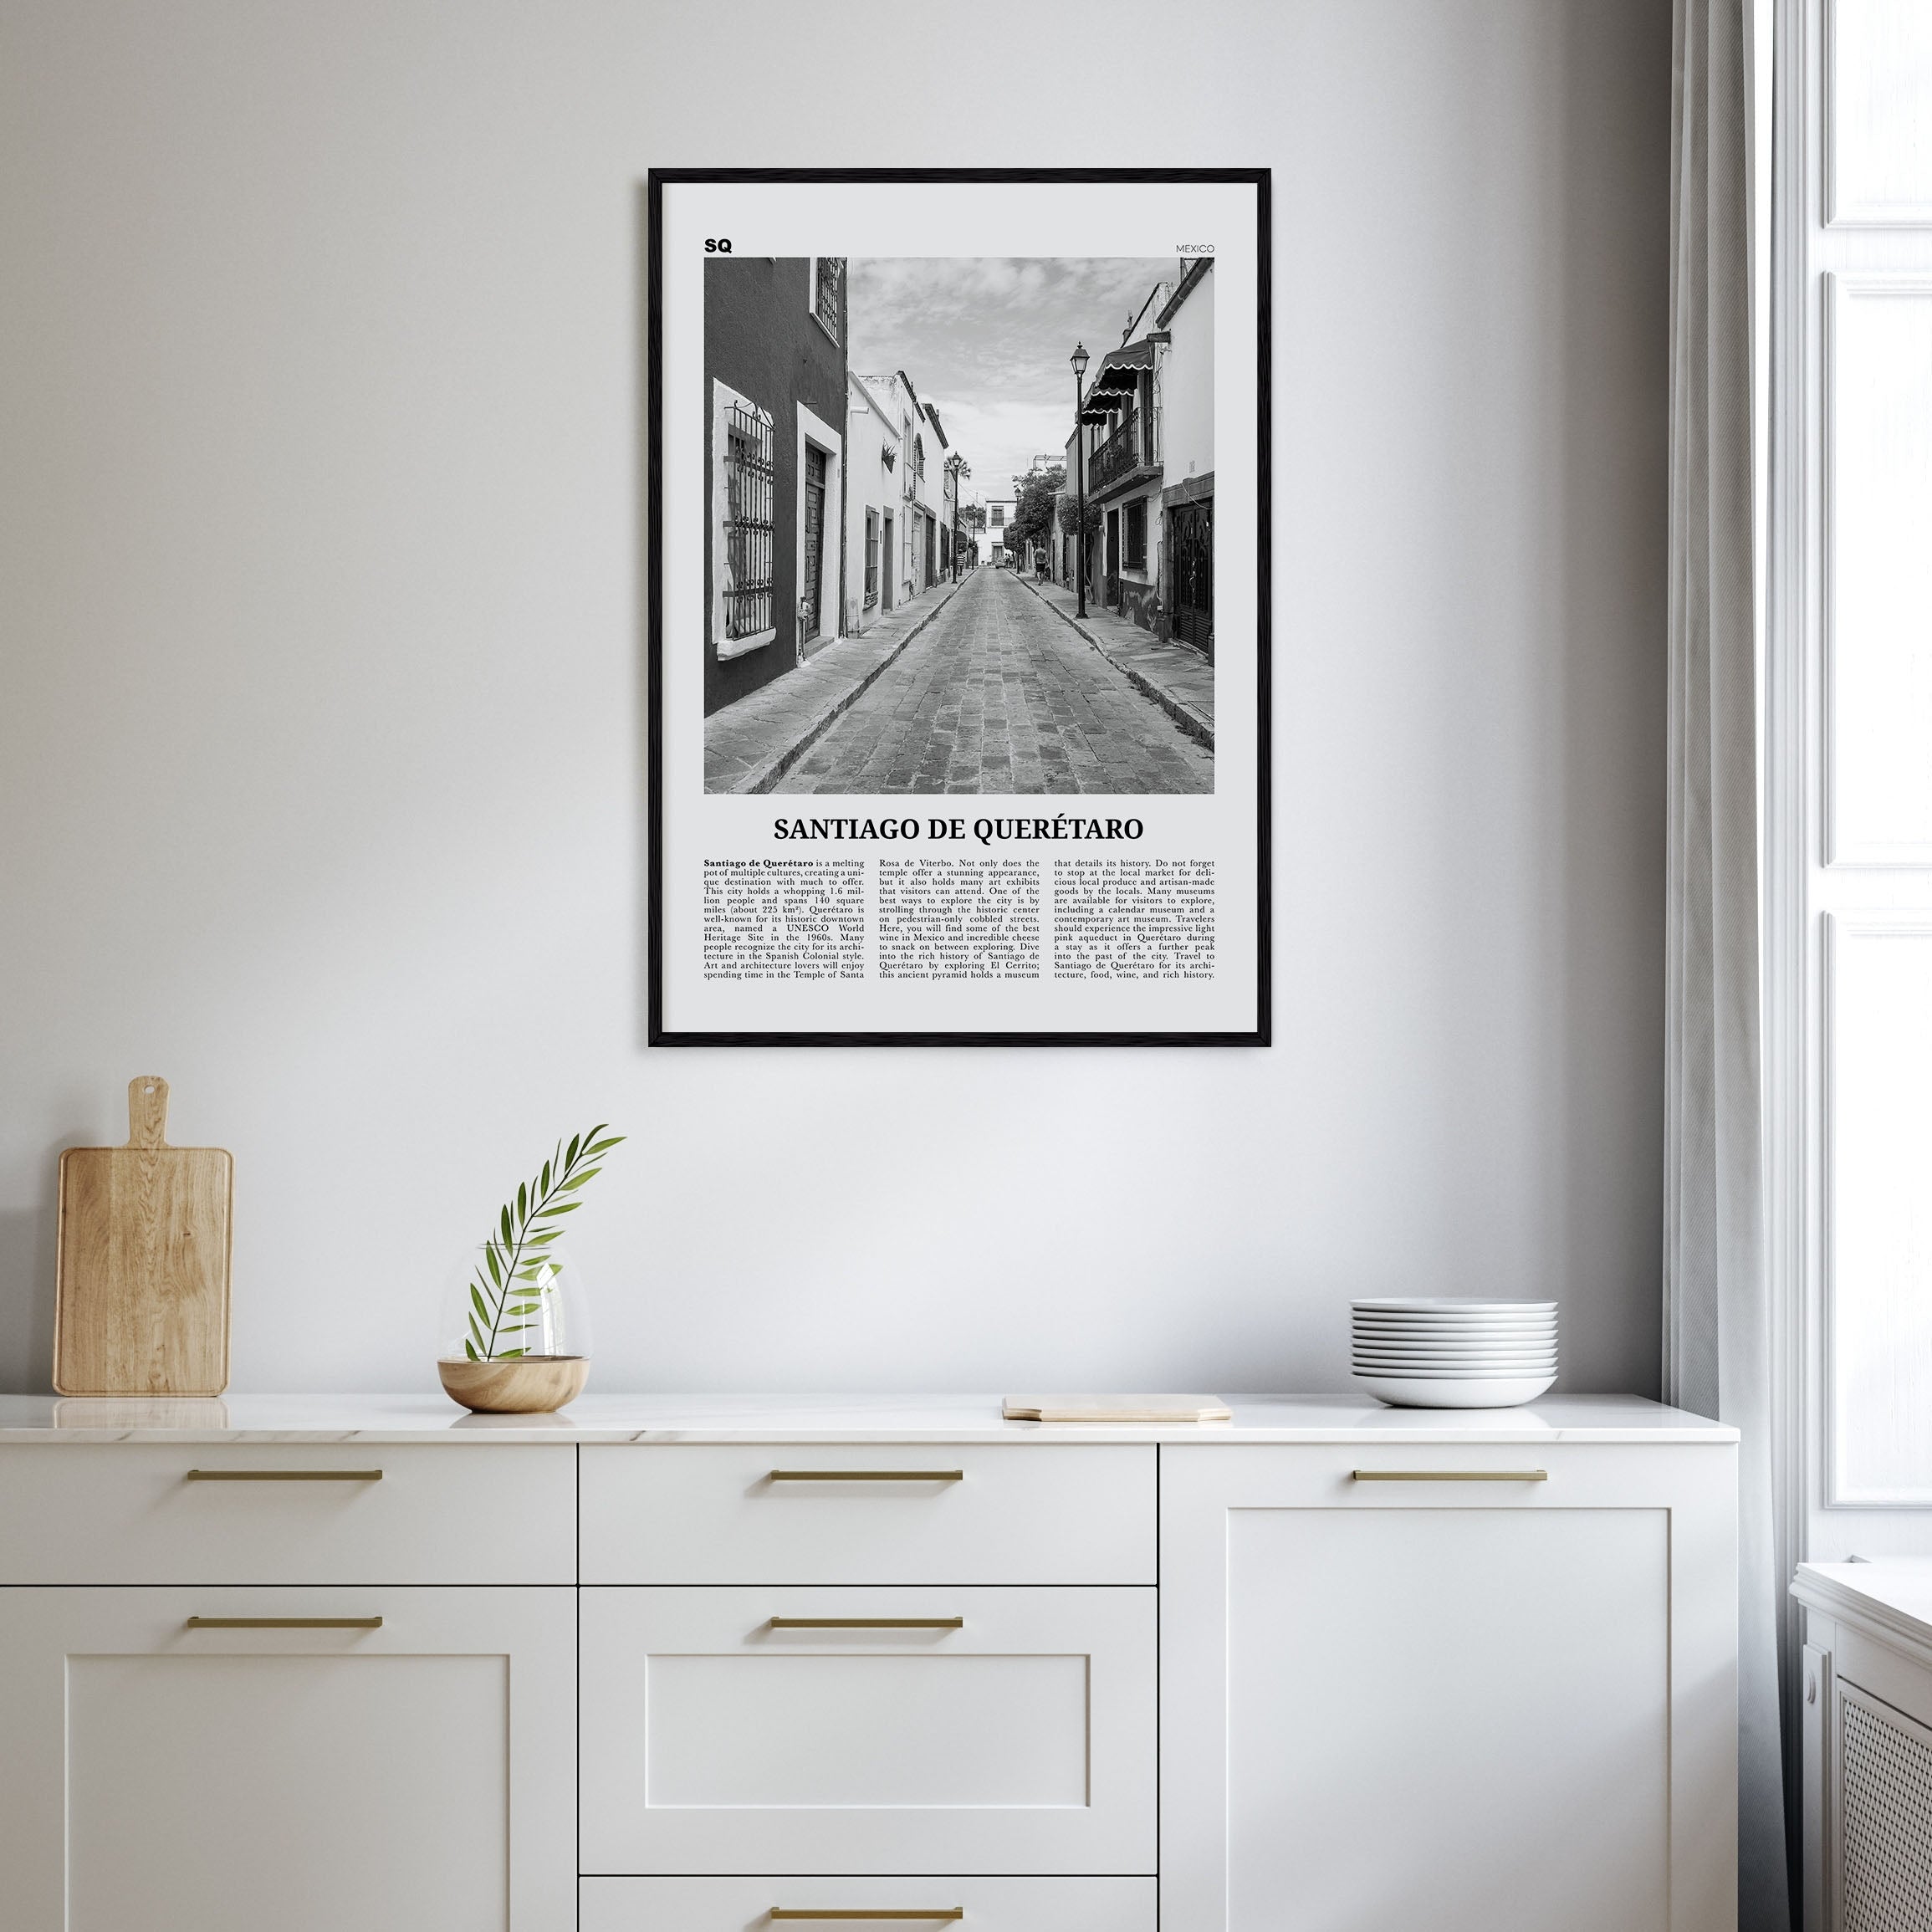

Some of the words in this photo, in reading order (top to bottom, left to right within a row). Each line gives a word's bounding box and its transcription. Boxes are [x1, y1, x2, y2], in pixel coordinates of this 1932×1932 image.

[704, 238, 732, 253] SQ
[774, 819, 919, 839] SANTIAGO
[928, 819, 965, 839] DE
[974, 814, 1143, 845] QUERÉTARO
[703, 859, 747, 869] Santiago
[749, 859, 761, 867] de
[763, 859, 814, 869] Querétaro
[815, 859, 823, 867] is
[832, 859, 865, 869] melting
[879, 859, 900, 867] Rosa
[904, 859, 915, 867] de
[919, 859, 954, 867] Viterbo.
[958, 859, 975, 867] Not
[979, 859, 999, 869] only
[1002, 859, 1022, 867] does
[1025, 859, 1040, 867] the
[1054, 859, 1071, 867] that
[1075, 859, 1103, 867] details
[1106, 859, 1117, 867] its
[1120, 859, 1152, 869] history.
[1155, 859, 1168, 867] Do
[1189, 859, 1215, 869] forget
[703, 870, 718, 878] pot
[718, 868, 730, 877] of
[730, 868, 766, 878] multiple
[766, 868, 804, 877] cultures,
[804, 868, 840, 878] creating
[846, 868, 865, 877] uni-
[879, 868, 908, 878] temple
[912, 868, 933, 877] offer
[946, 868, 984, 878] stunning
[723, 877, 772, 886] destination
[776, 877, 795, 886] with
[800, 877, 824, 886] much
[841, 877, 864, 886] offer.
[1054, 877, 1076, 886] cious
[1079, 877, 1100, 886] local
[1102, 877, 1137, 887] produce
[1140, 877, 1157, 886] and
[1158, 877, 1215, 886] artisan-made
[1054, 887, 1079, 897] goods
[1083, 887, 1094, 897] by
[1147, 887, 1173, 897] Many
[1180, 897, 1215, 907] explore,
[730, 906, 758, 916] (about
[809, 906, 854, 916] Querétaro
[878, 906, 915, 916] strolling
[918, 906, 953, 916] through
[897, 915, 963, 925] pedestrian-only
[1054, 916, 1114, 925] contemporary
[1084, 924, 1131, 934] experience
[1148, 924, 1193, 934] impressive
[1195, 924, 1215, 934] light
[1054, 933, 1073, 943] pink
[1078, 933, 1118, 943] aqueduct
[1137, 933, 1182, 943] Querétaro
[1186, 933, 1215, 943] during
[703, 943, 733, 953] people
[734, 943, 775, 953] recognize
[793, 943, 810, 953] city
[973, 943, 1015, 953] exploring.
[765, 952, 800, 962] Spanish
[842, 952, 864, 962] style.
[841, 961, 865, 971] enjoy
[879, 961, 923, 971] Querétaro
[928, 961, 939, 971] by
[944, 961, 985, 971] exploring
[1005, 961, 1040, 970] Cerrito;
[1054, 961, 1092, 971] Santiago
[1110, 961, 1155, 971] Querétaro
[932, 970, 968, 980] pyramid
[1090, 970, 1112, 979] food,
[1116, 970, 1139, 979] wine,
[1183, 970, 1215, 980] history.
